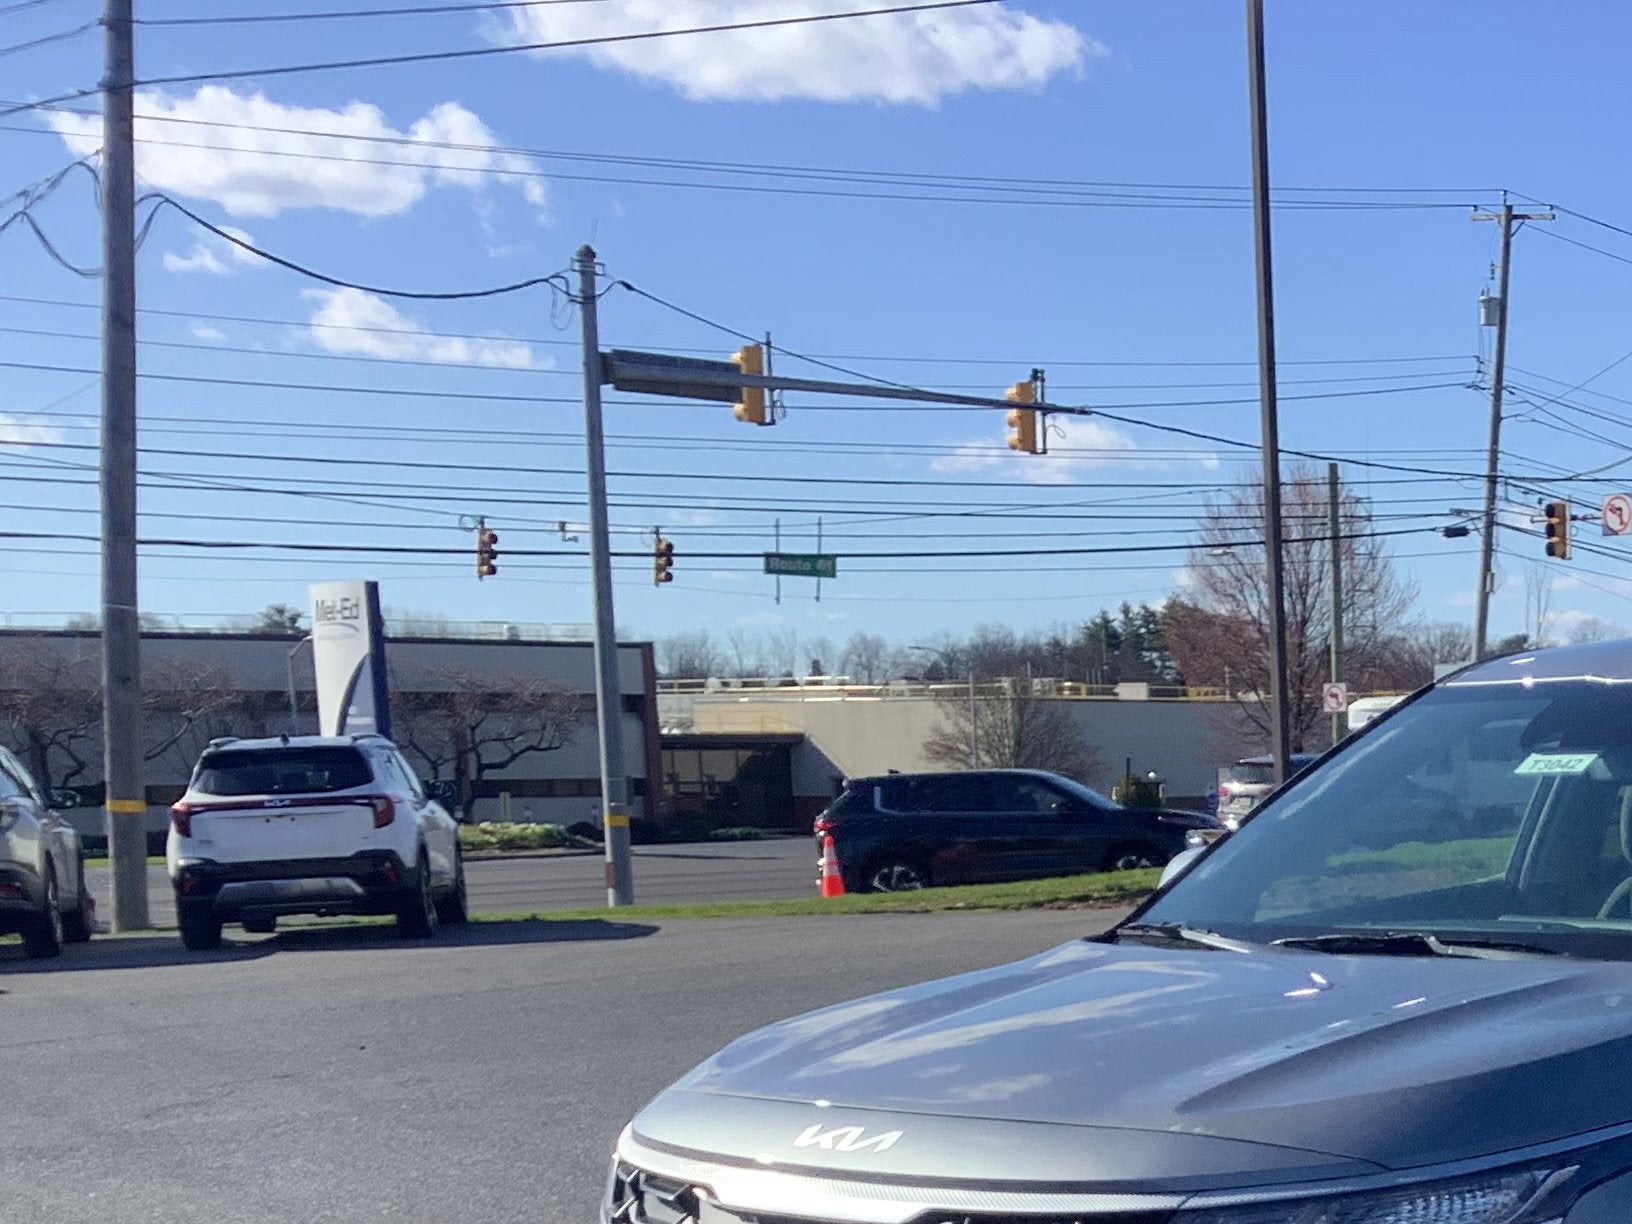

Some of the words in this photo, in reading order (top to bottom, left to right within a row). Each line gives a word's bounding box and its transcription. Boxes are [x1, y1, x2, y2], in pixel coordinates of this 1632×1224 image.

[768, 557, 812, 571] Route
[315, 597, 360, 622] Met-Ed
[1528, 758, 1585, 771] T3042
